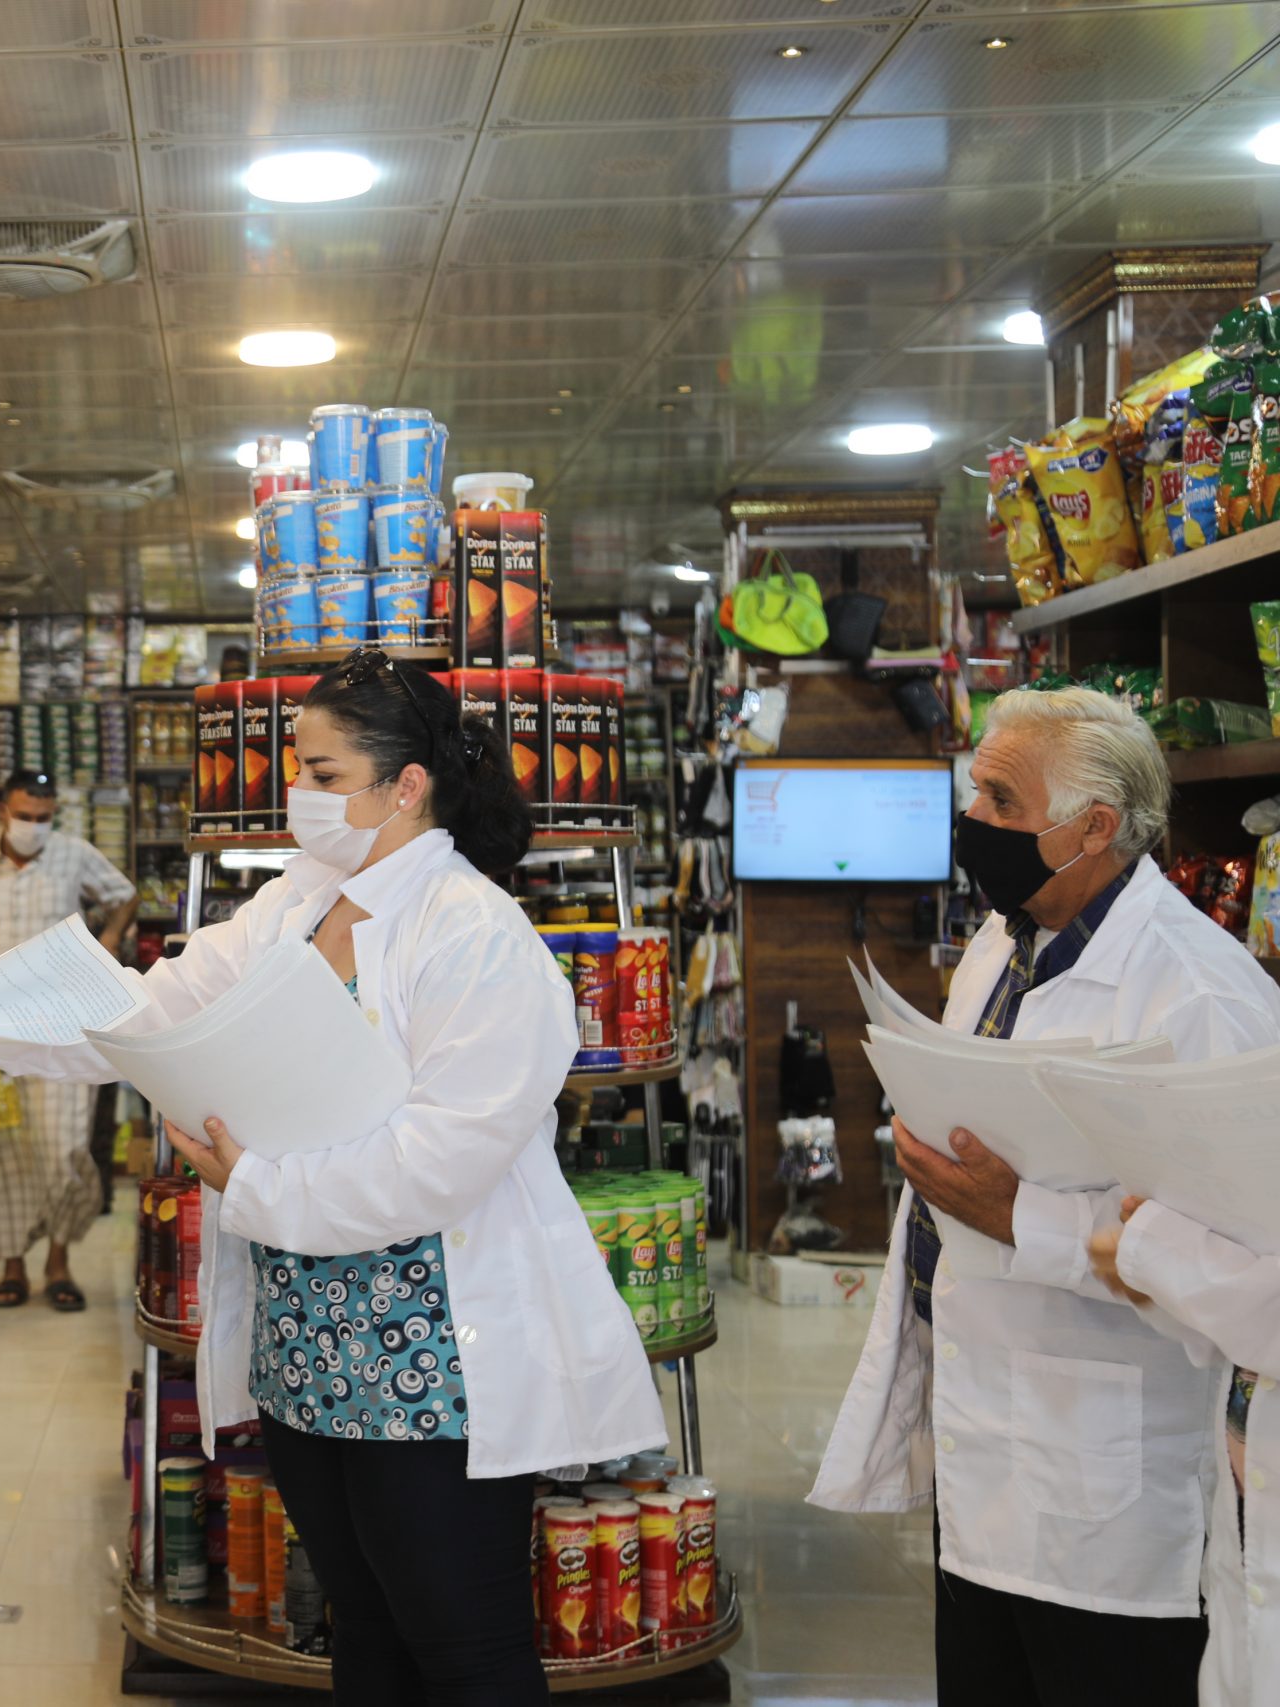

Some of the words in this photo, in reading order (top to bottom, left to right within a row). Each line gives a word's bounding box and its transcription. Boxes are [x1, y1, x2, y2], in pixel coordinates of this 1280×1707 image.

[467, 537, 497, 550] Doritos
[500, 539, 536, 552] Doritos
[470, 555, 495, 569] STAX
[504, 556, 534, 570] STAX
[461, 700, 497, 713] Doritos
[509, 701, 539, 714] Doritos
[246, 722, 267, 737] STAX
[513, 719, 537, 733] STAX
[555, 719, 576, 733] STAX
[581, 720, 601, 734] STAX
